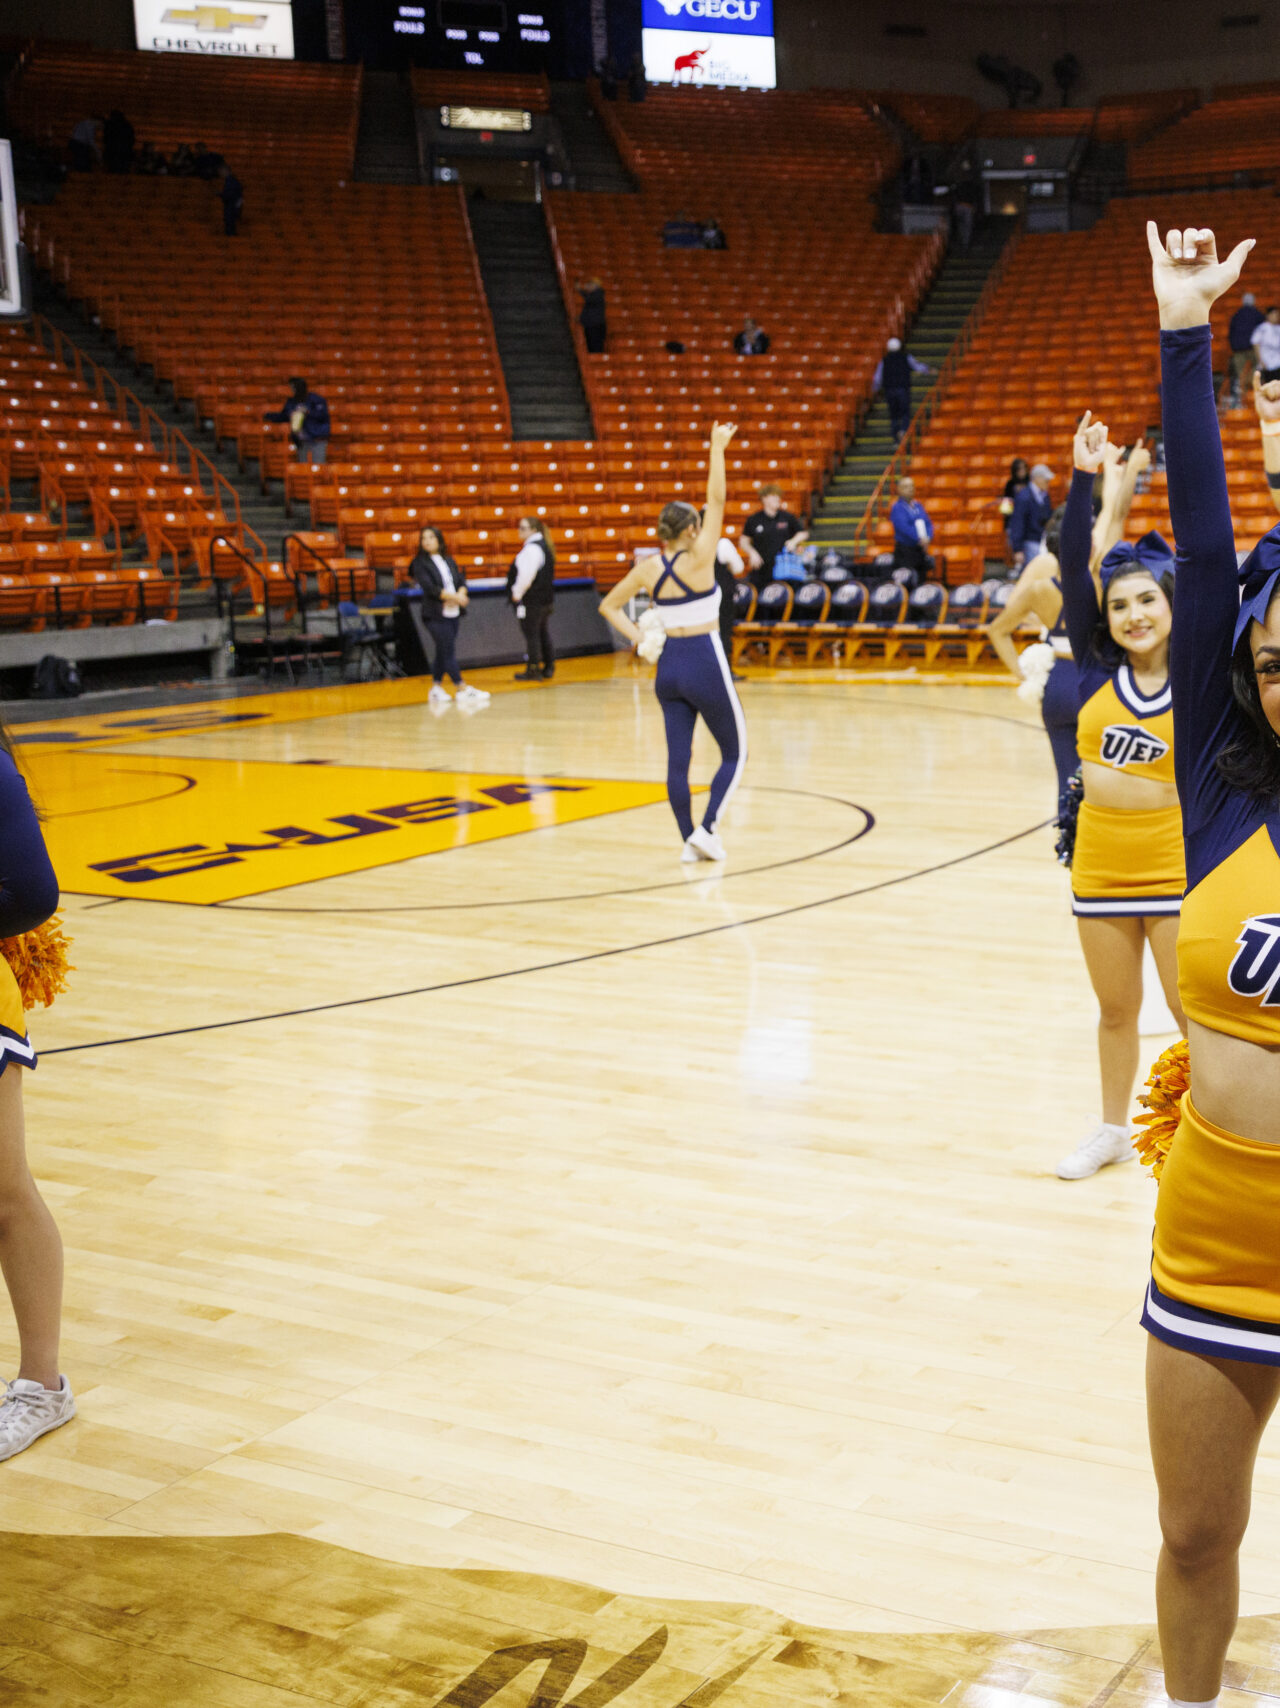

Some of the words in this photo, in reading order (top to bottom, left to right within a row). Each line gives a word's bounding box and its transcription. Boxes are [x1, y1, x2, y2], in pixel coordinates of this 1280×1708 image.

[685, 0, 758, 21] GECU
[152, 37, 279, 56] CHEVROLET
[1101, 725, 1169, 768] UTEP
